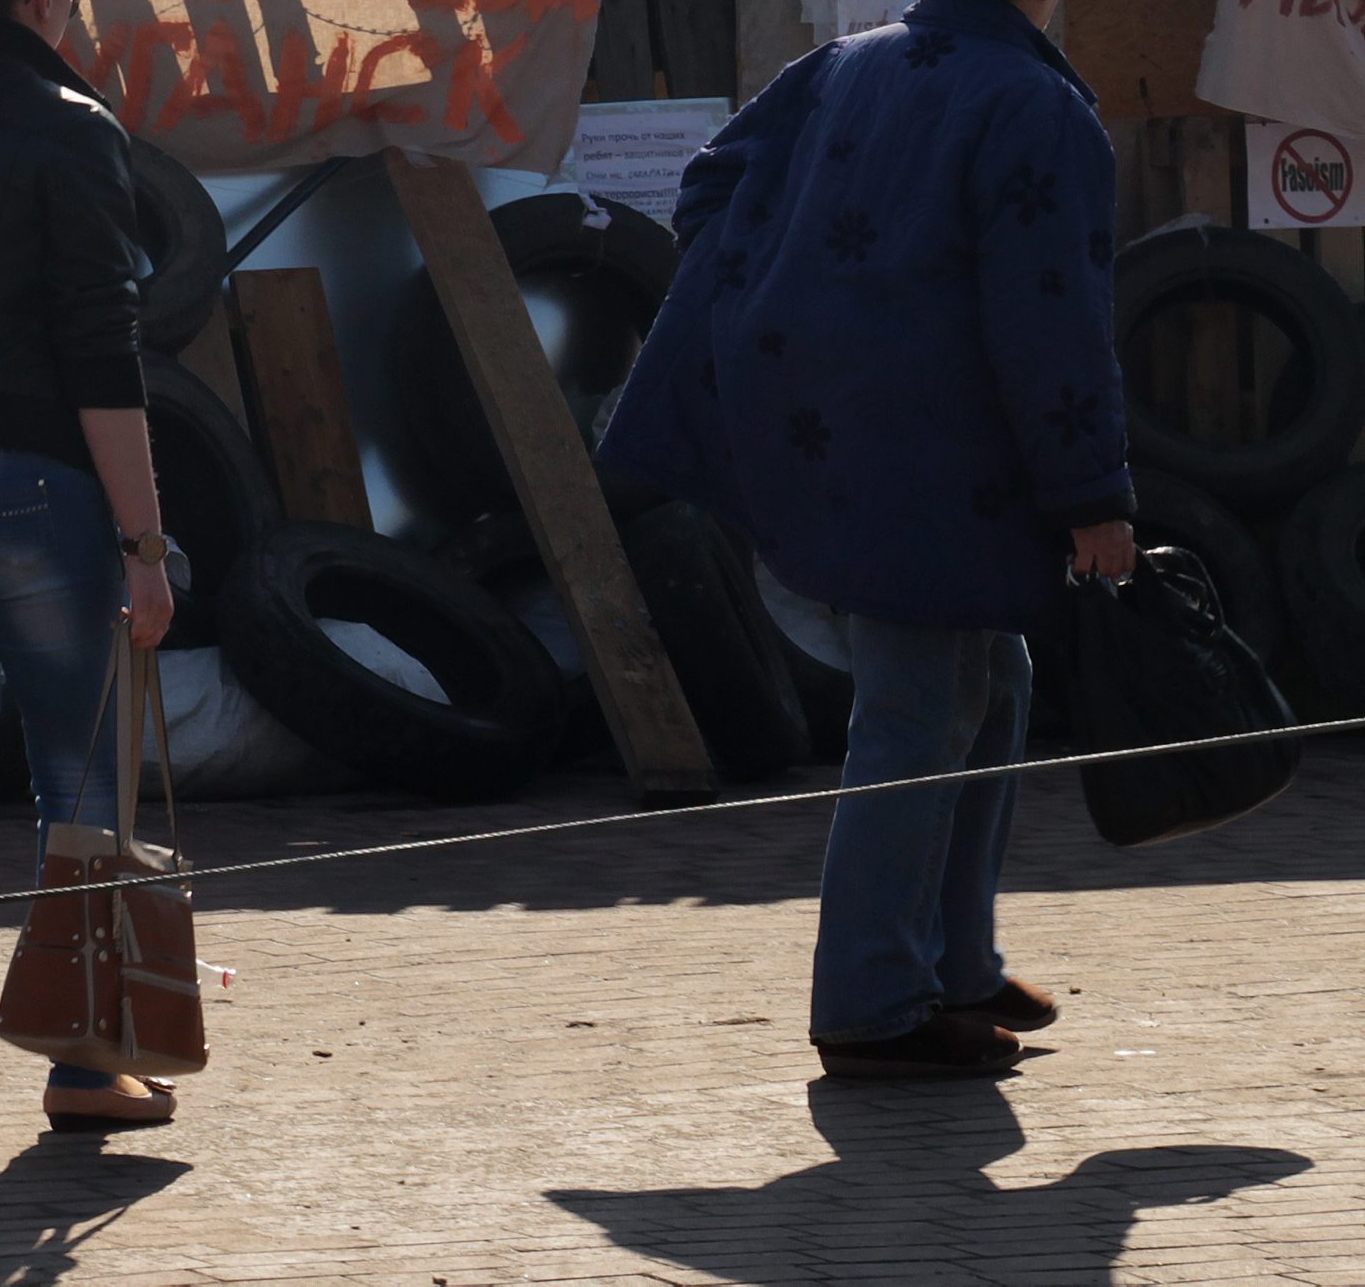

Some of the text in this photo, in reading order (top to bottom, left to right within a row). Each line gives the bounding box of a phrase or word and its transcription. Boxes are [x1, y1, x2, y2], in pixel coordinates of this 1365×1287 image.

[608, 133, 639, 143] прочь
[641, 131, 653, 140] от
[583, 151, 613, 162] ребят
